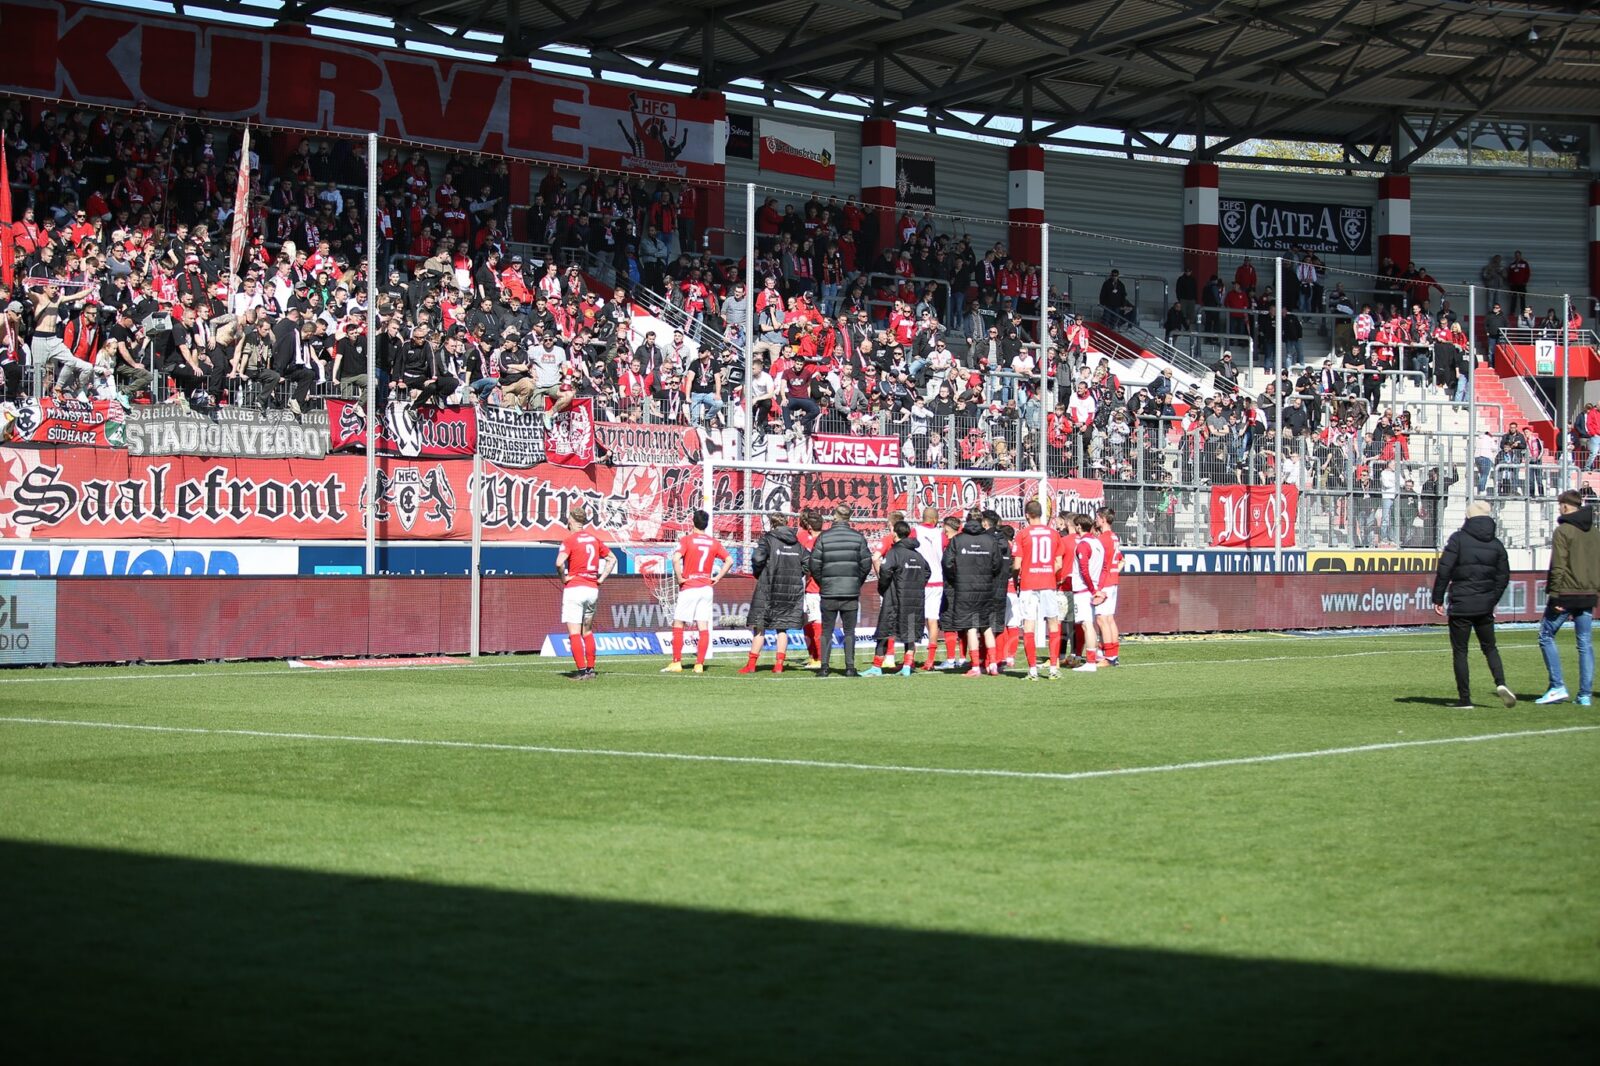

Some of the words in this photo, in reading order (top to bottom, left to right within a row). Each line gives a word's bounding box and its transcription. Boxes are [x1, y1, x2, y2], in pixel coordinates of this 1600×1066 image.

[0, 4, 588, 160] KURVE
[642, 100, 669, 115] HFC
[1223, 201, 1240, 210] HFC
[1344, 208, 1362, 218] HFC
[1253, 238, 1271, 249] No
[1274, 240, 1339, 253] Surender
[1540, 345, 1552, 357] 17
[53, 399, 94, 410] SKTION
[46, 408, 104, 424] MANSFELD
[486, 407, 544, 427] ELEKOM
[48, 425, 97, 444] SÜDHARZ
[125, 421, 331, 456] STADIONVERBOT
[479, 447, 501, 462] NICHT
[398, 471, 418, 482] HFC
[11, 463, 347, 525] Saalefront
[663, 468, 764, 522] Köhen
[585, 543, 597, 571] 2
[1031, 536, 1052, 564] 10
[698, 546, 710, 572] 7
